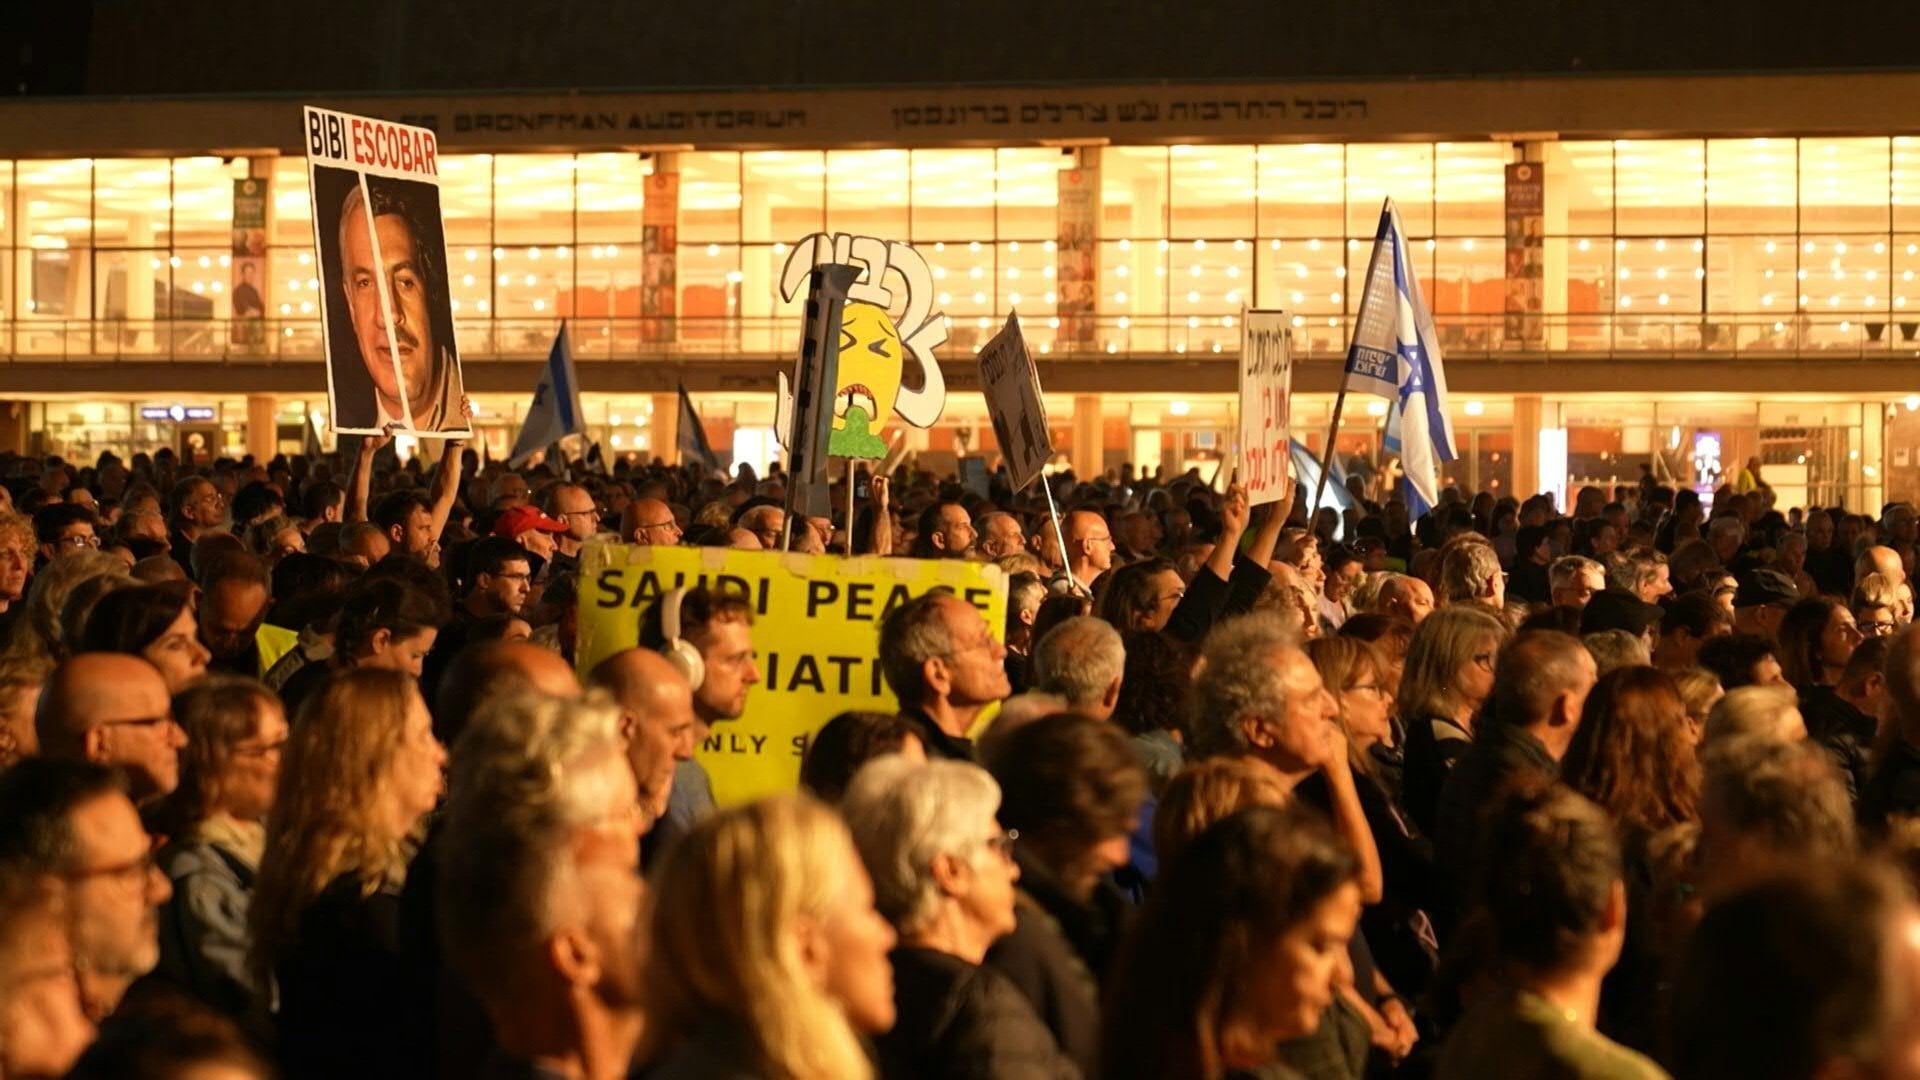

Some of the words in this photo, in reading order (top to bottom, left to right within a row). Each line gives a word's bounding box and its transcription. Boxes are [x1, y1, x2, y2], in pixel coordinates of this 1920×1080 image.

[628, 110, 807, 130] AUDITORIUM
[308, 110, 348, 160] BIBI
[351, 119, 438, 175] ESCOBAR
[806, 580, 992, 621] PEAE
[703, 733, 768, 754] NLY
